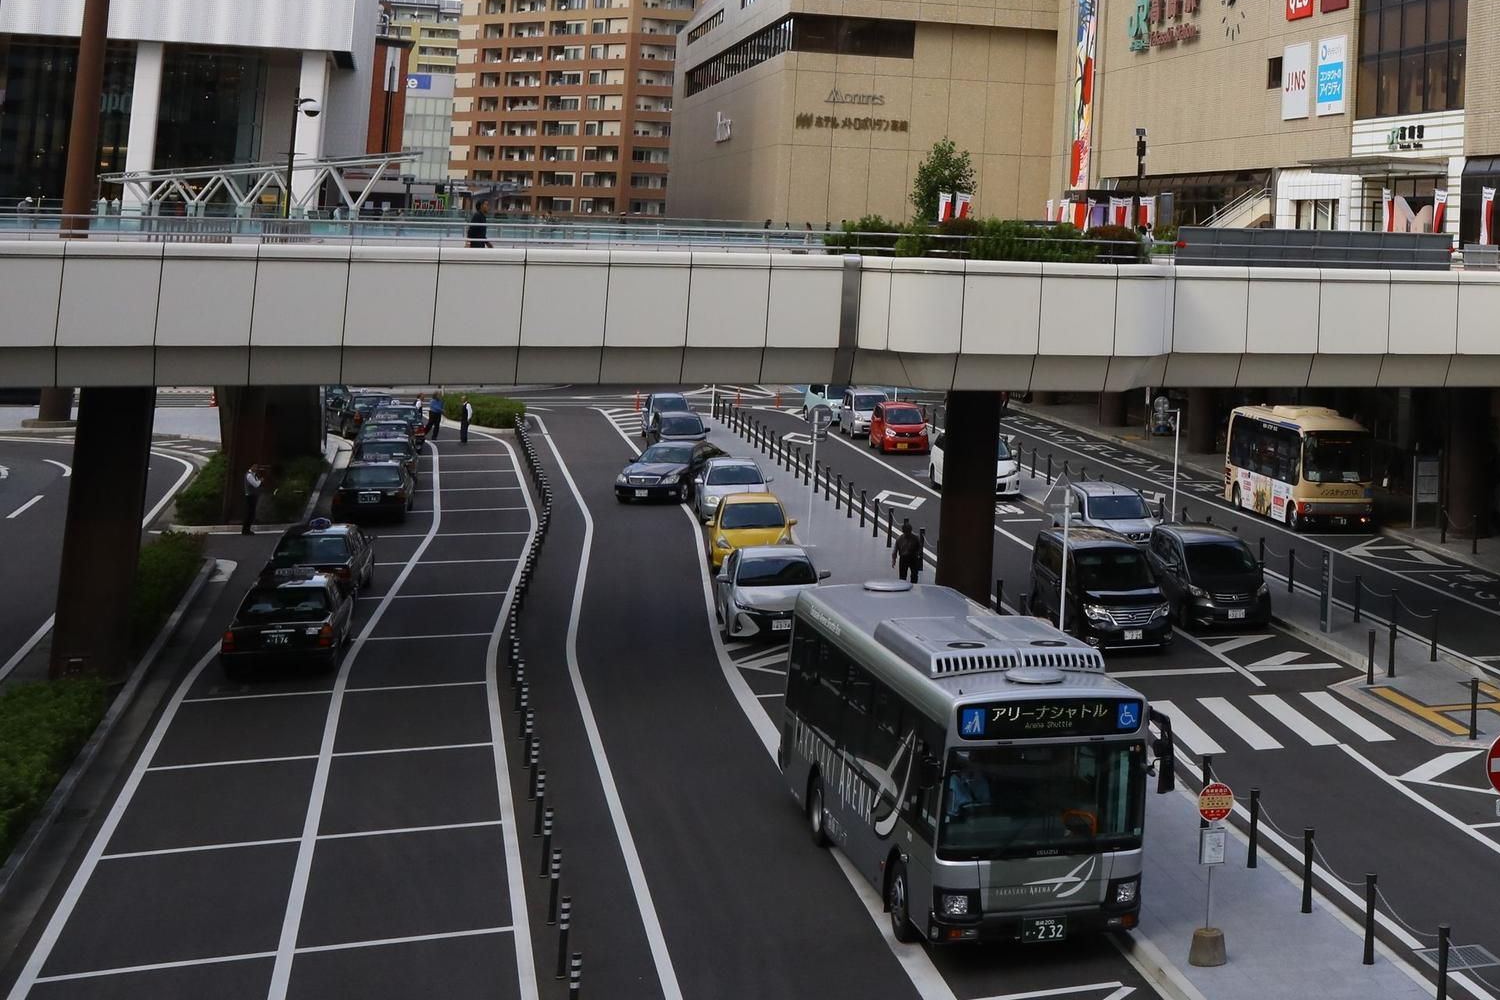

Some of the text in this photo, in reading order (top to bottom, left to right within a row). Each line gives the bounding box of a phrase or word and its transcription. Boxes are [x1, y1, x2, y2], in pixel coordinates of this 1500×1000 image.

[992, 704, 1108, 721] アリーナシャトル
[838, 744, 872, 825] ARENA
